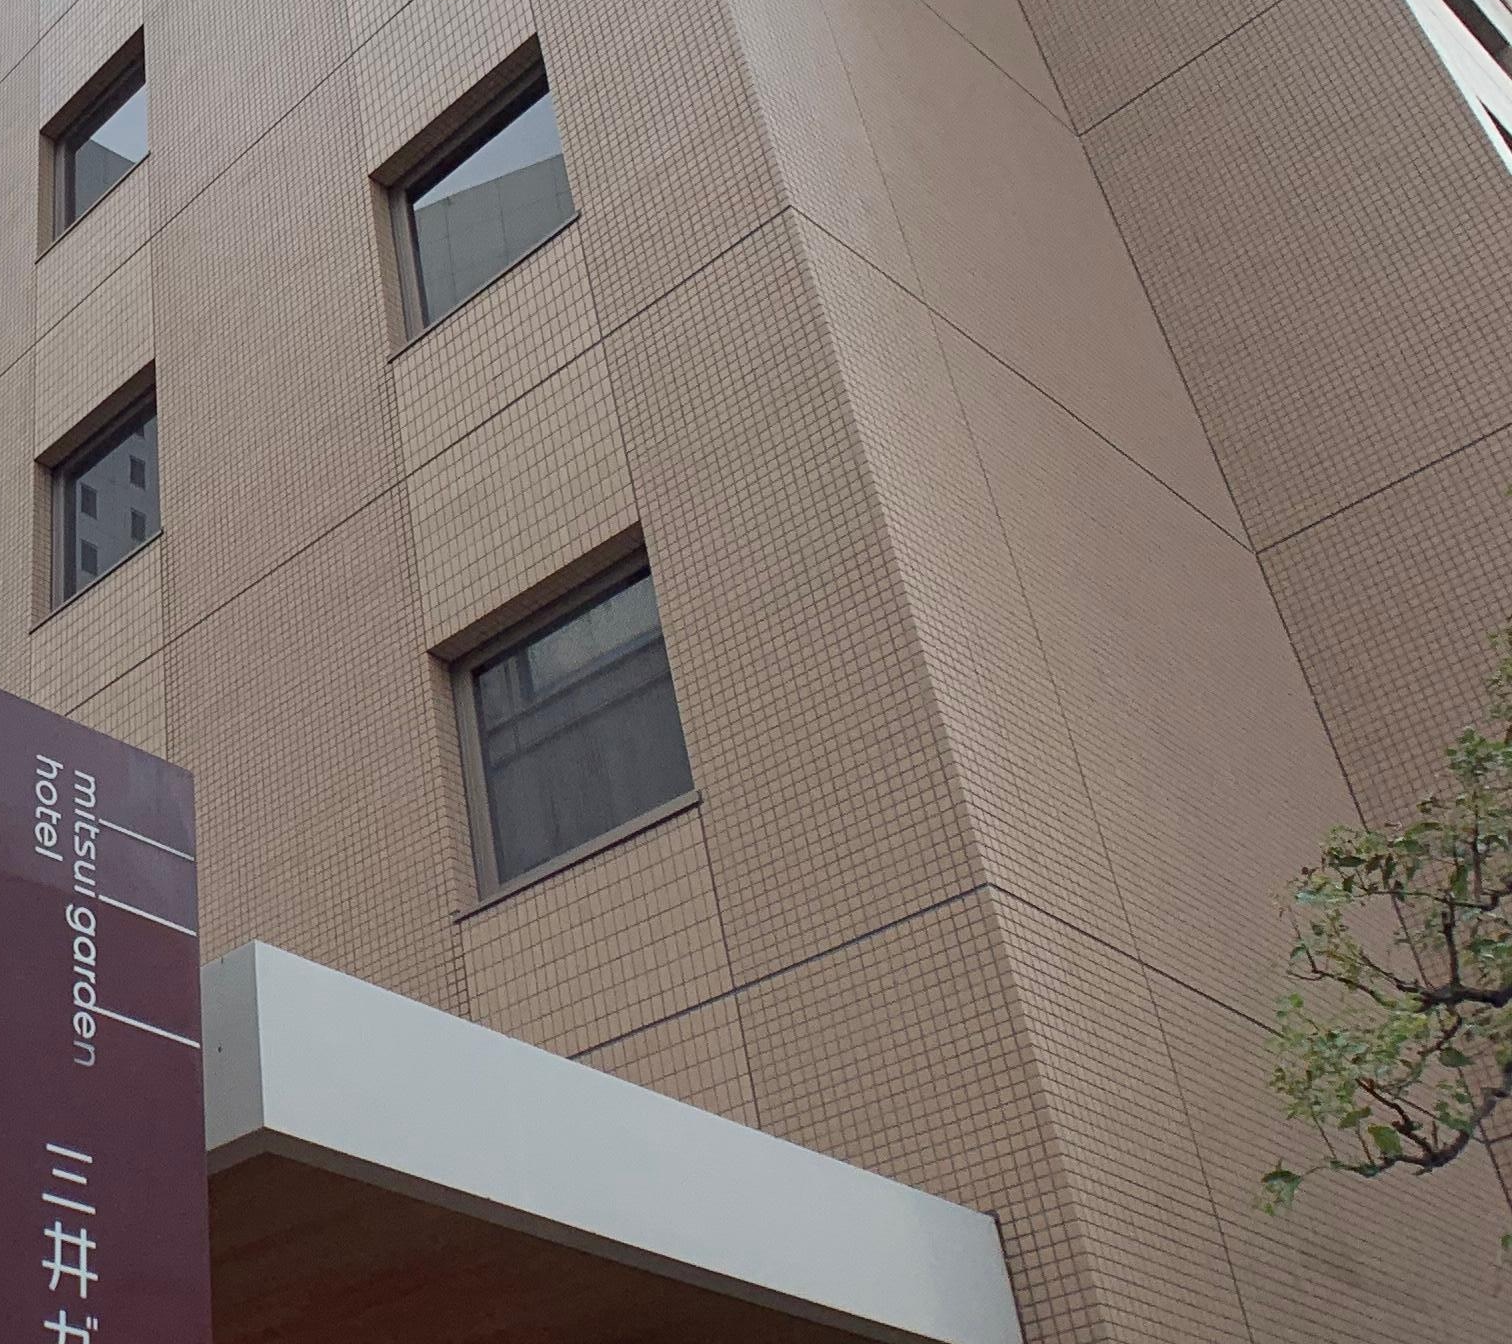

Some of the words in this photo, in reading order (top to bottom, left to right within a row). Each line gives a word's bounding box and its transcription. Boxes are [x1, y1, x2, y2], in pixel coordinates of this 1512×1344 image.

[34, 753, 64, 862] hotel
[74, 769, 98, 898] mitsui
[65, 903, 98, 1067] garden
